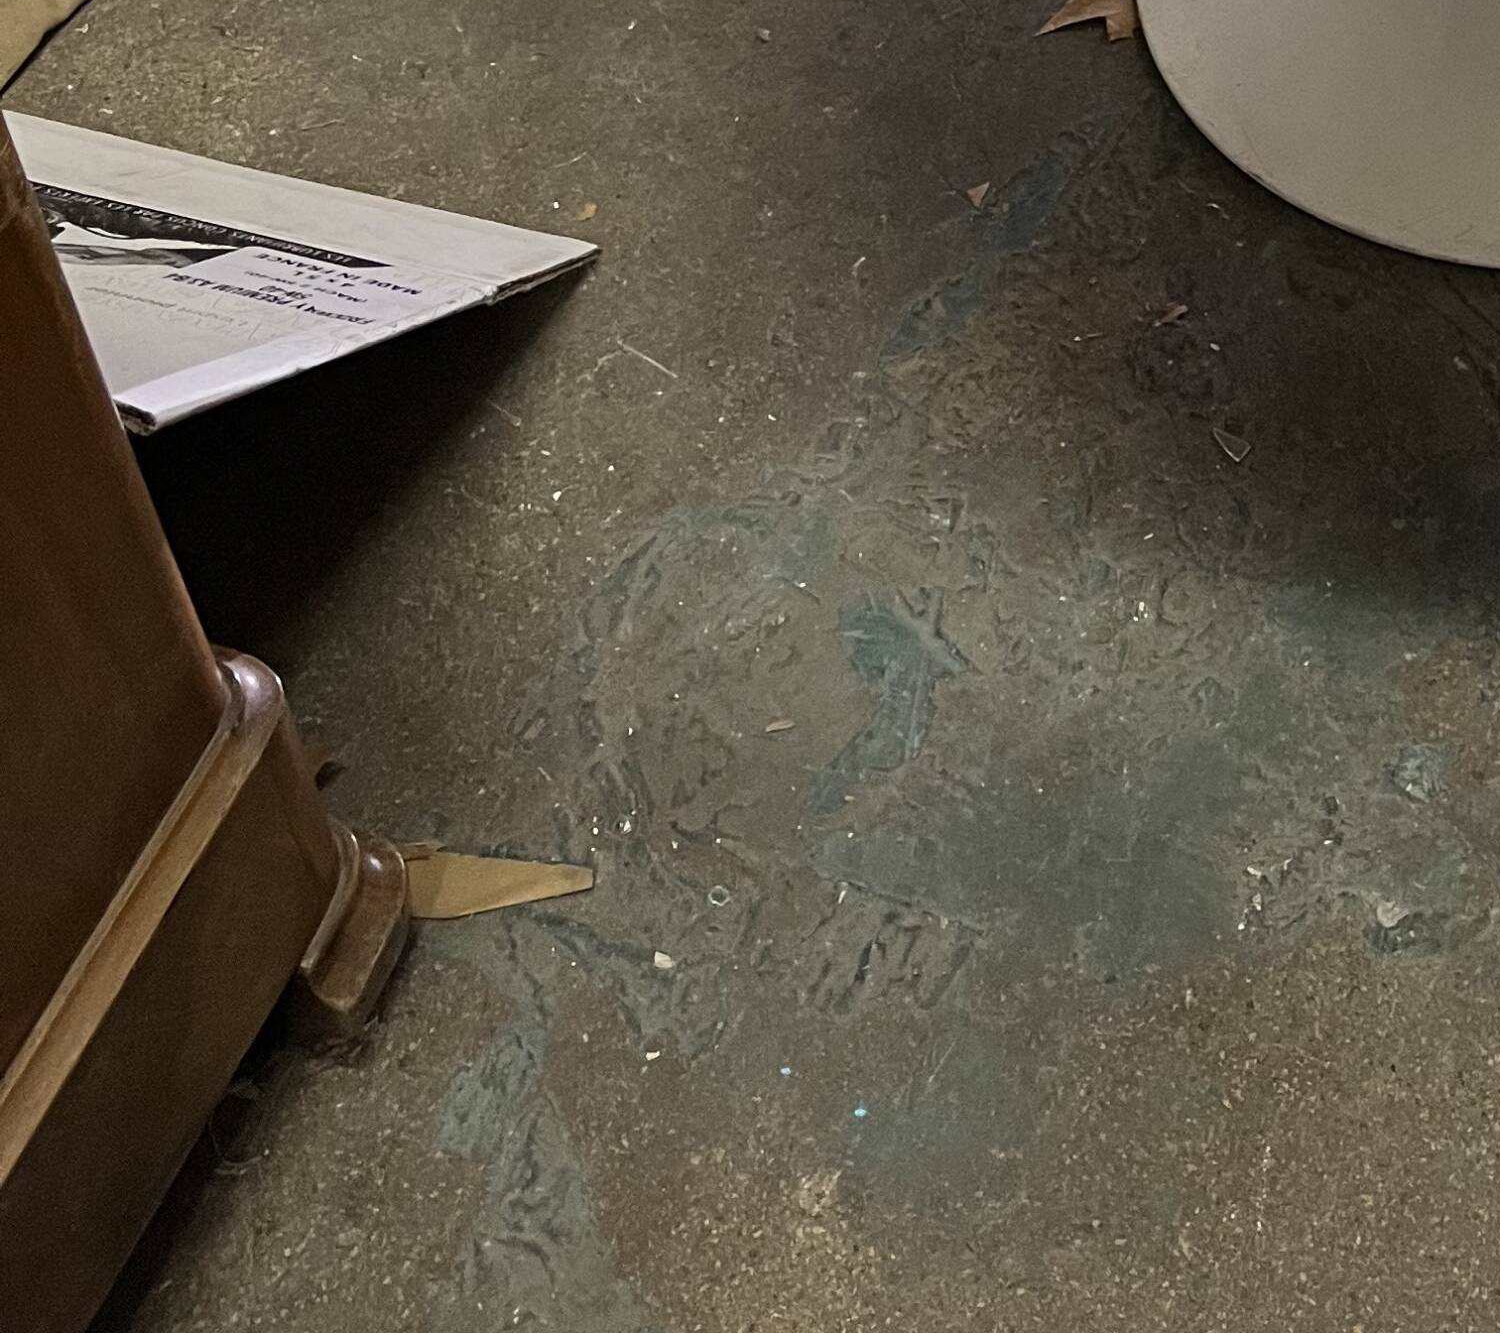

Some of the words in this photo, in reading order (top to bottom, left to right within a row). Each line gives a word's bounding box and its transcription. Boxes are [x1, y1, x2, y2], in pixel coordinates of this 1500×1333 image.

[253, 253, 336, 275] FRANCE
[338, 273, 361, 281] IN
[212, 284, 293, 305] PREMIUM
[367, 279, 422, 295] MADE
